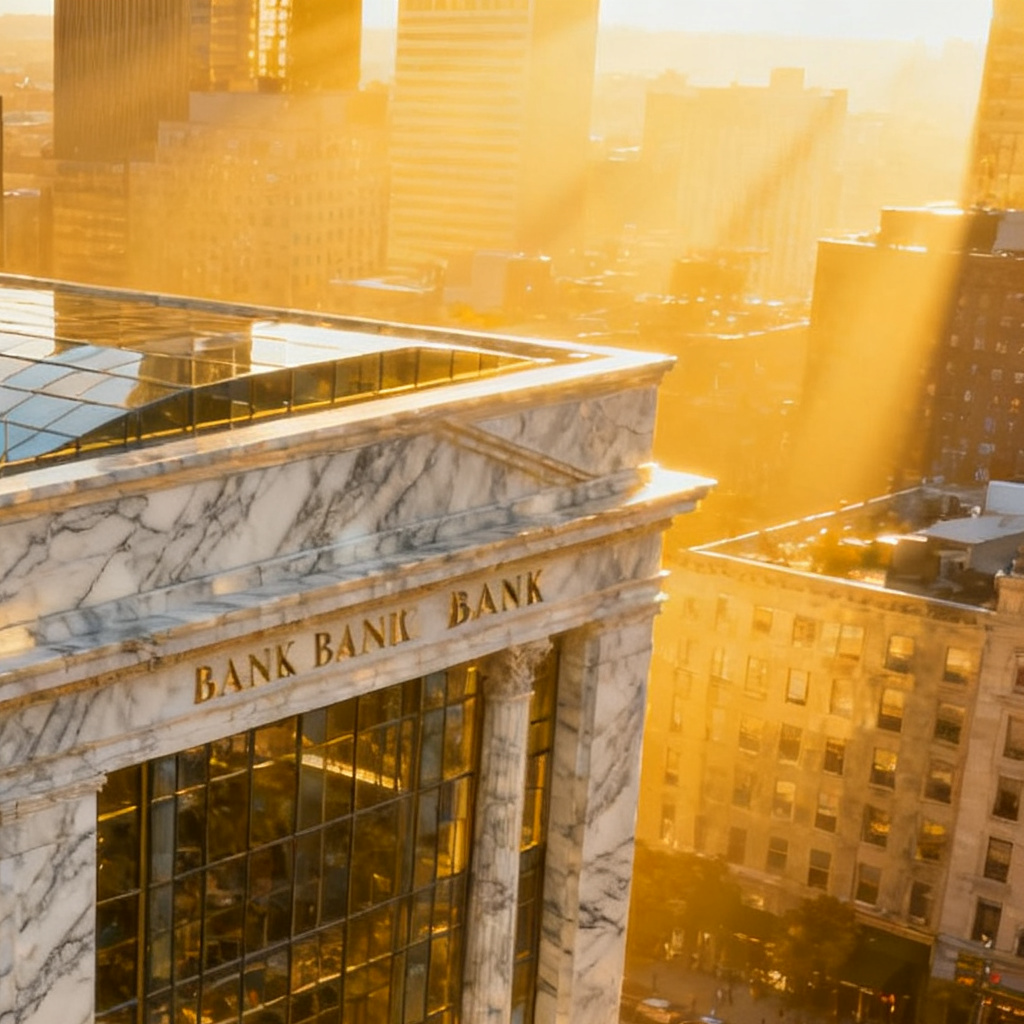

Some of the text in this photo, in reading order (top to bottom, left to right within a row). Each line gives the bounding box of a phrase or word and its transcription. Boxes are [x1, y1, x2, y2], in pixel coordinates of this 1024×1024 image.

[193, 569, 544, 705] BANK BANK BANK
